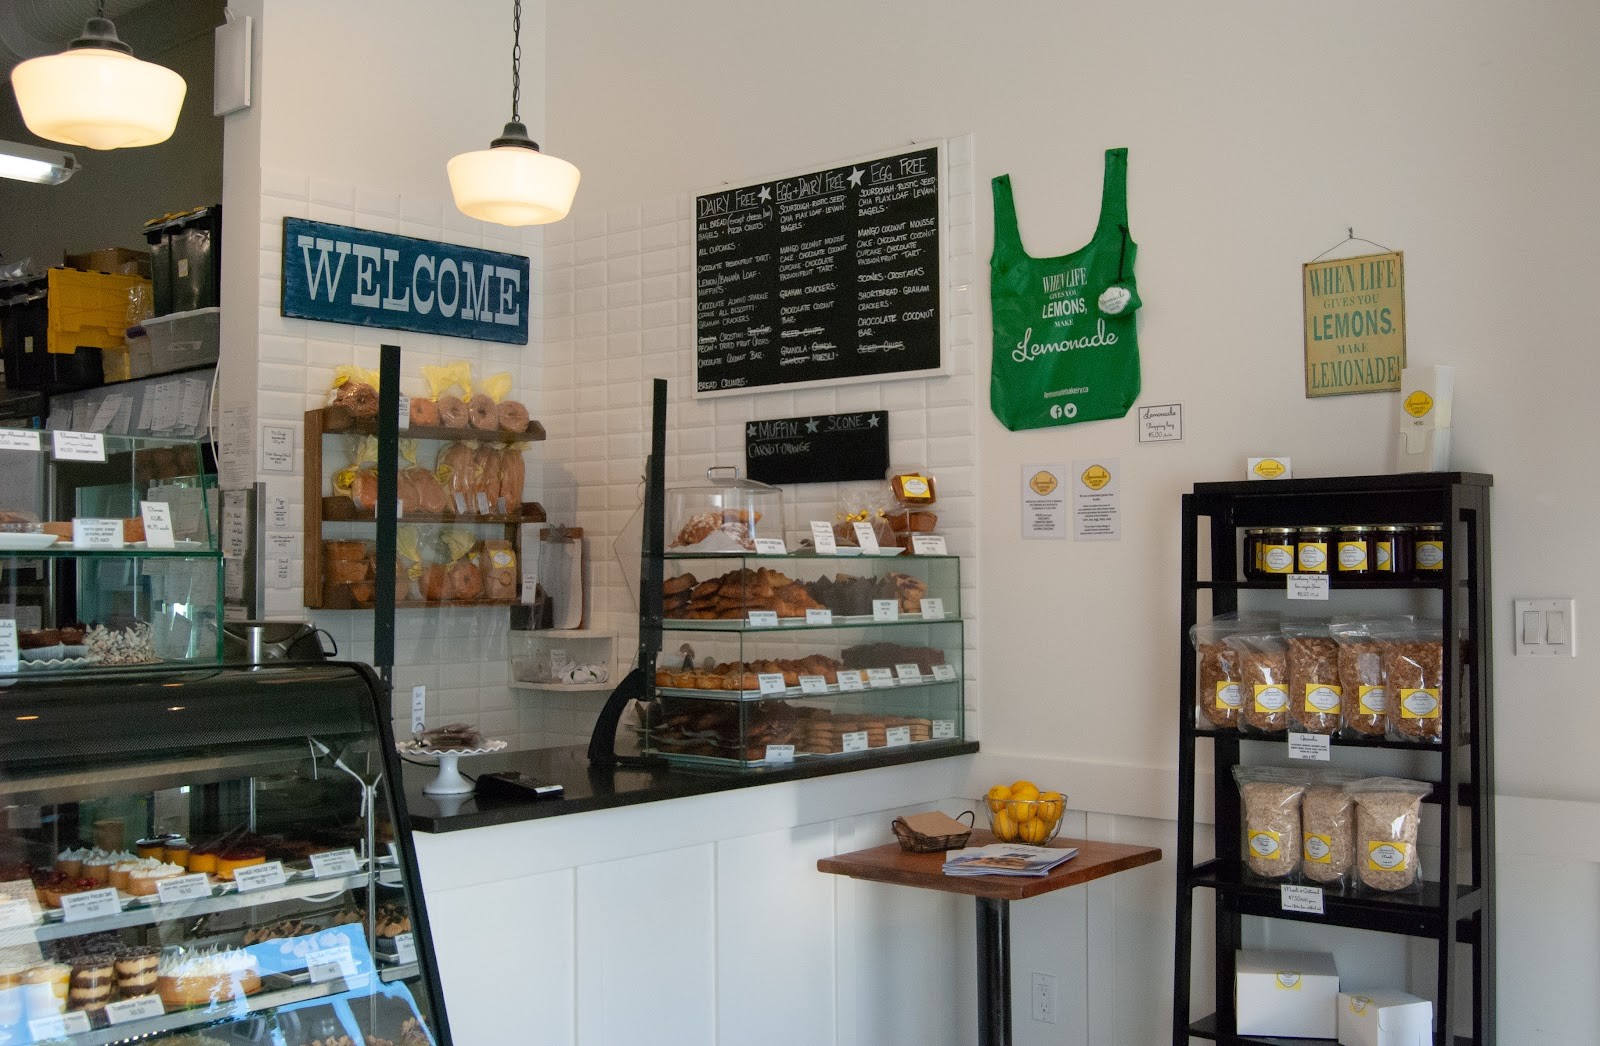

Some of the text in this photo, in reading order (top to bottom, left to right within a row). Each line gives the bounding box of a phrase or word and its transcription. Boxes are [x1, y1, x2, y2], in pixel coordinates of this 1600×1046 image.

[871, 157, 927, 182] EGG FREE
[826, 171, 846, 191] FREE
[859, 177, 935, 197] SOURDOUGH RUSTIC SEED
[698, 190, 758, 216] DAIRY FREE
[858, 199, 872, 207] CHIA
[892, 191, 909, 200] LOAF
[914, 185, 935, 198] LEVAIN
[779, 195, 845, 215] SOURDOUGH RUSTIC SEED
[780, 202, 844, 223] CHIA FLAX LOAF LEVAIN
[858, 205, 885, 216] BAGELS
[698, 222, 763, 241] BAGELS PIZZA CRUSTS
[699, 223, 709, 231] ALL
[710, 219, 726, 228] BREAD
[780, 222, 802, 232] BAGELS
[858, 218, 935, 237] MANGO COCONUT MOUSSE
[780, 245, 799, 254] MANGO
[825, 234, 845, 245] MOUSSE
[856, 229, 936, 248] CAKE CHOCOLATE COCONUT
[699, 243, 736, 256] ALL CUPCAKES
[780, 254, 793, 263] CAKE
[799, 249, 826, 260] CHOCOLATE
[856, 242, 917, 257] CUPCAKE CHOCOLATE
[901, 249, 922, 258] TART
[698, 263, 722, 273] CHOCOLATE
[755, 254, 769, 262] TART
[779, 256, 834, 272] CUPCAKE CHOCOLATE
[816, 264, 834, 272] TART
[298, 235, 520, 325] WELCOME
[743, 270, 757, 280] LOAF
[857, 267, 924, 282] SCONES CROSTATAS
[1043, 267, 1087, 293] WHEN LIFE
[1308, 259, 1396, 297] WHEN LIFE
[698, 286, 724, 296] MUFFINS
[780, 283, 836, 299] GRAHAM CRACKERS
[858, 285, 929, 300] SHORTBREAD GRAHAM
[1049, 289, 1078, 300] GIVES YOU
[698, 292, 768, 310] CHOCOLATE ALMOND SPARKLE
[858, 300, 890, 311] CRACKERS
[1042, 297, 1088, 319] LEMONS,
[1324, 294, 1379, 308] GIVES YOU
[731, 305, 754, 314] BISCOTTI
[780, 304, 811, 315] CHOCOLATE
[698, 315, 750, 329] GRAHAM CRACKERS
[782, 316, 795, 324] BAR
[858, 309, 934, 326] CHOCOLATE COCONUT
[1054, 319, 1074, 327] MAKE
[1313, 307, 1396, 342] LEMONS,
[720, 332, 744, 342] CROSTINI
[858, 328, 873, 337] BAR
[1012, 317, 1119, 362] Lemonade
[698, 344, 714, 353] PECAN
[719, 342, 735, 350] DRIED
[780, 345, 807, 356] GRANOLA
[1338, 343, 1368, 354] MAKE
[698, 358, 722, 368] CHOCOLATE
[750, 350, 762, 360] BAR
[812, 352, 835, 361] MUESLI
[1312, 356, 1400, 388] LEMONADE!
[698, 378, 745, 390] BREAD CRUMBS
[1143, 407, 1176, 420] Lemonade
[758, 414, 864, 439] MUFFIN SCONE
